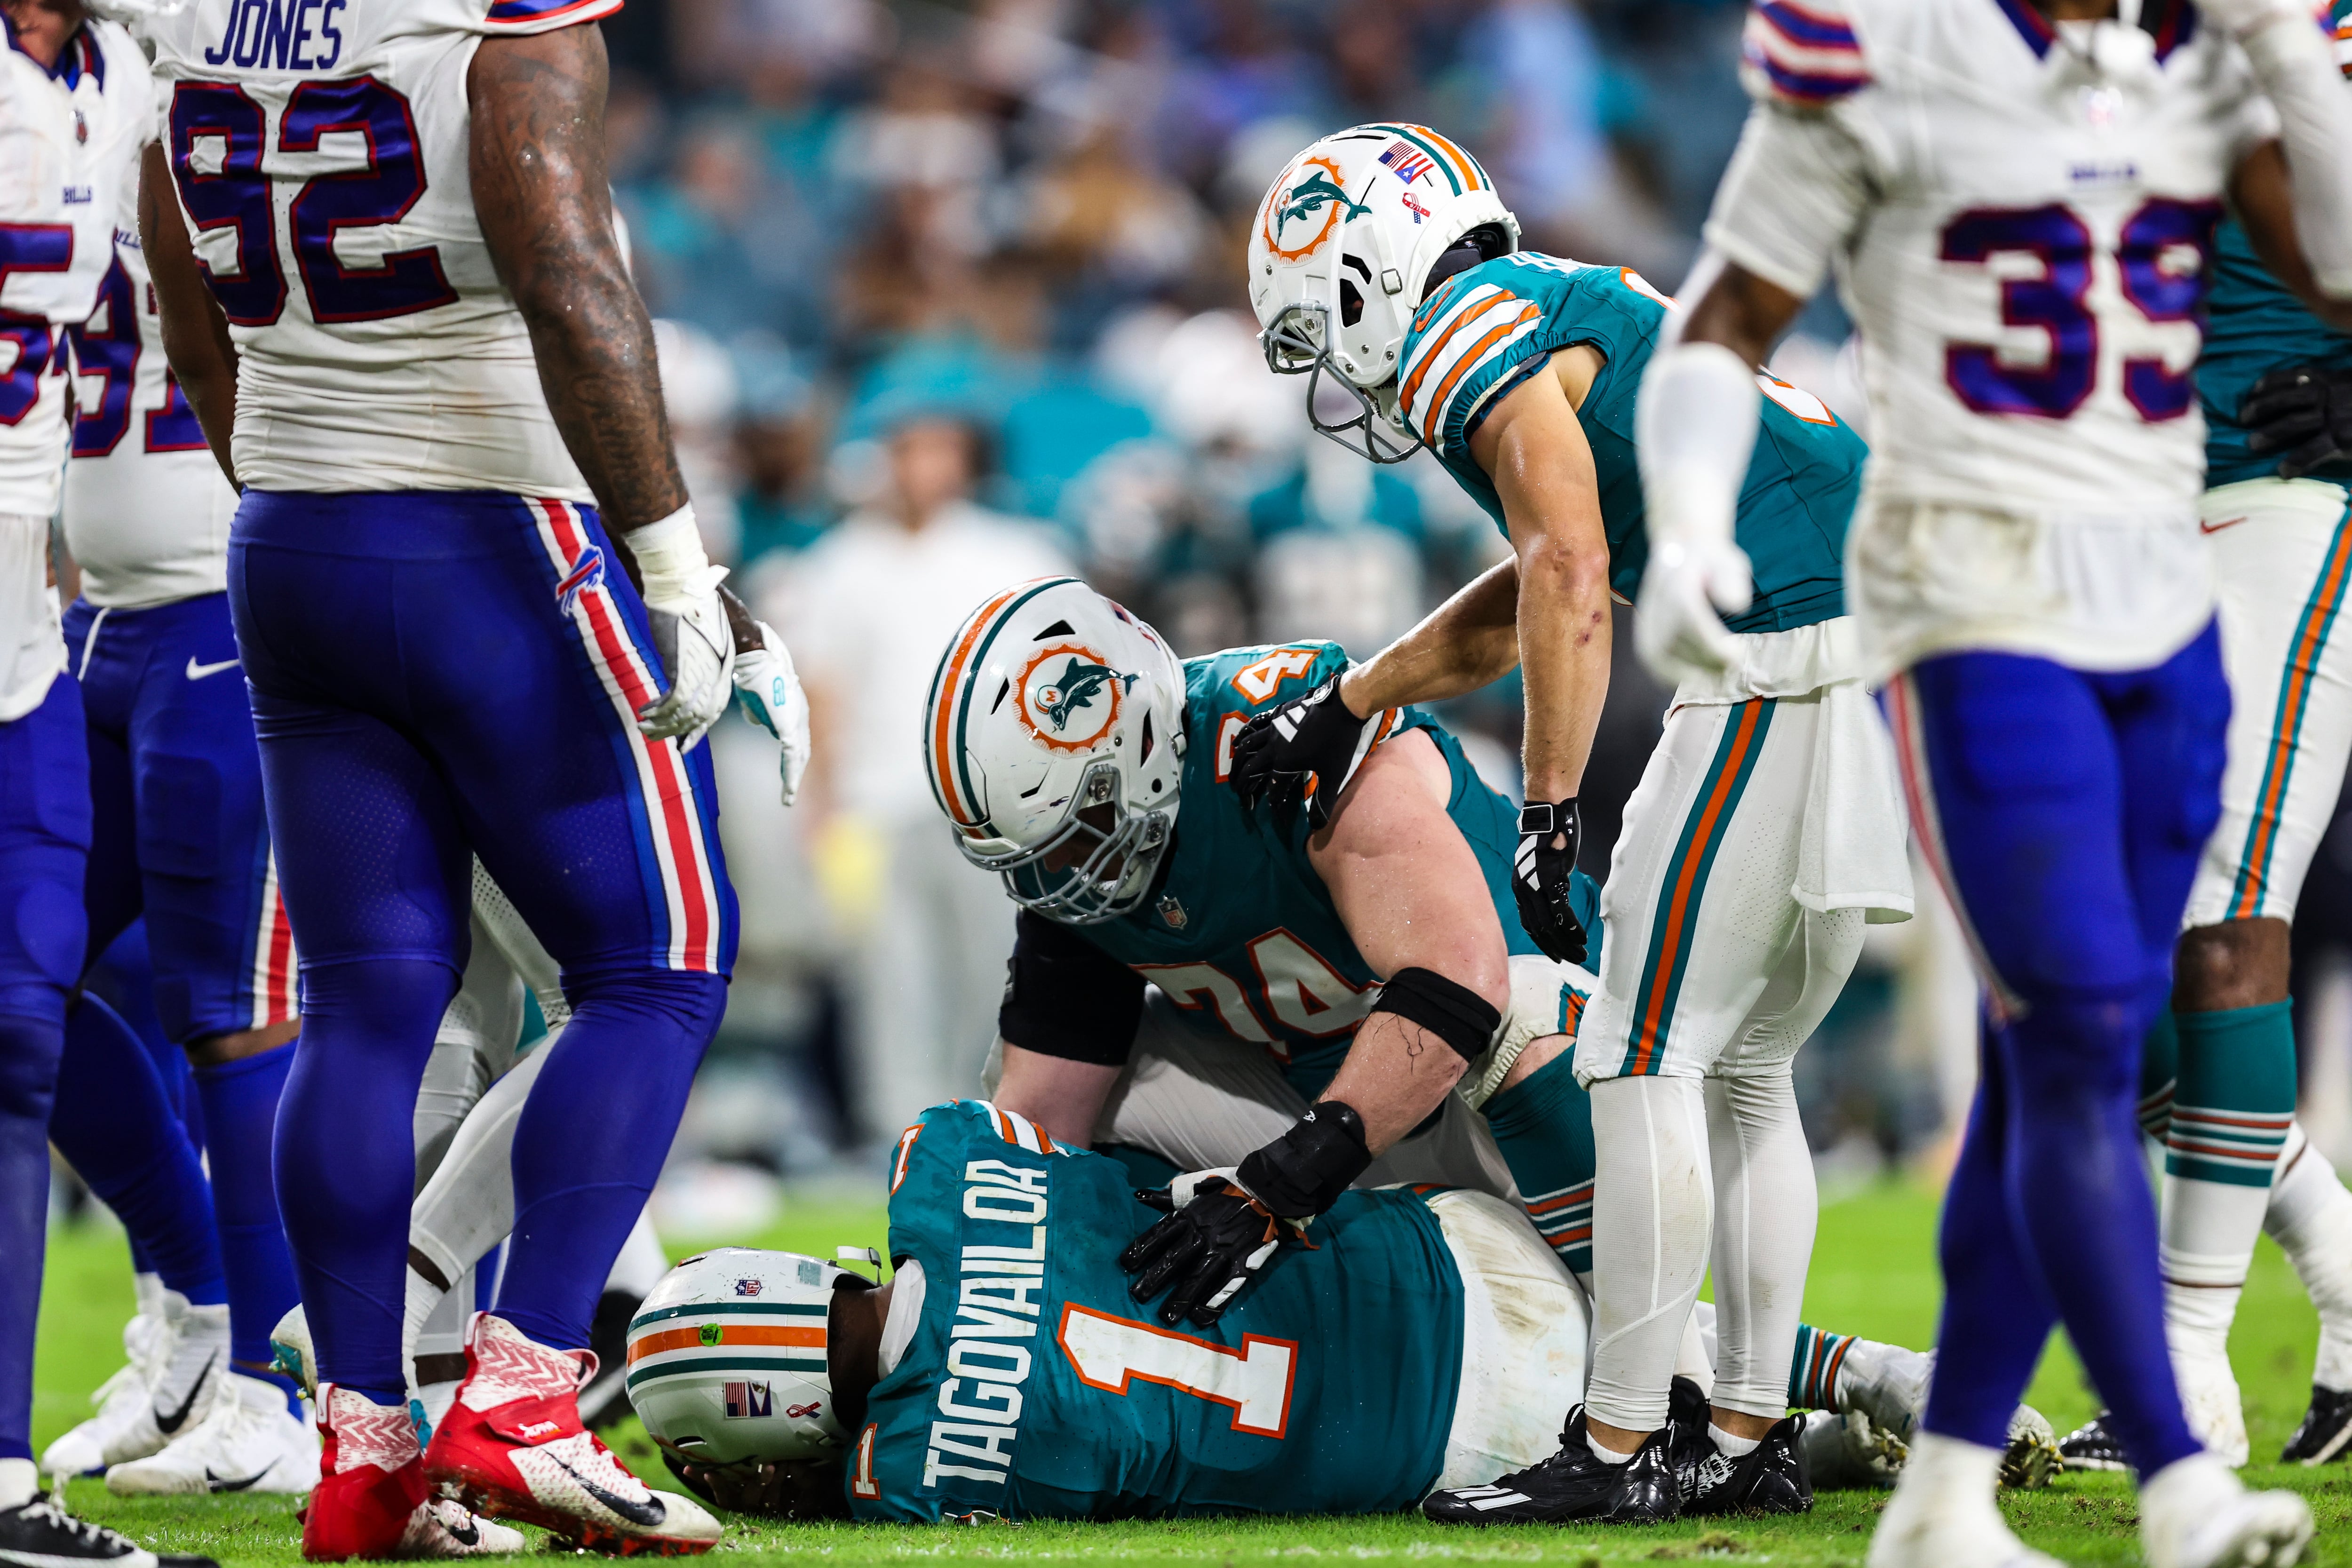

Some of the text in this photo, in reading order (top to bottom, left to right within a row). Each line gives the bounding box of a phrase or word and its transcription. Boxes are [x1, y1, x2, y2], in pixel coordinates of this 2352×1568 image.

[205, 0, 348, 70] JONES
[170, 73, 460, 327] 92
[1940, 197, 2221, 422] 39
[1046, 690, 1057, 702] M
[1128, 926, 1387, 1065] 74
[746, 1281, 760, 1294] NFL
[923, 1159, 1048, 1488] TAGOVAILOA
[1057, 1301, 1299, 1440] 1
[851, 1422, 881, 1500] 1
